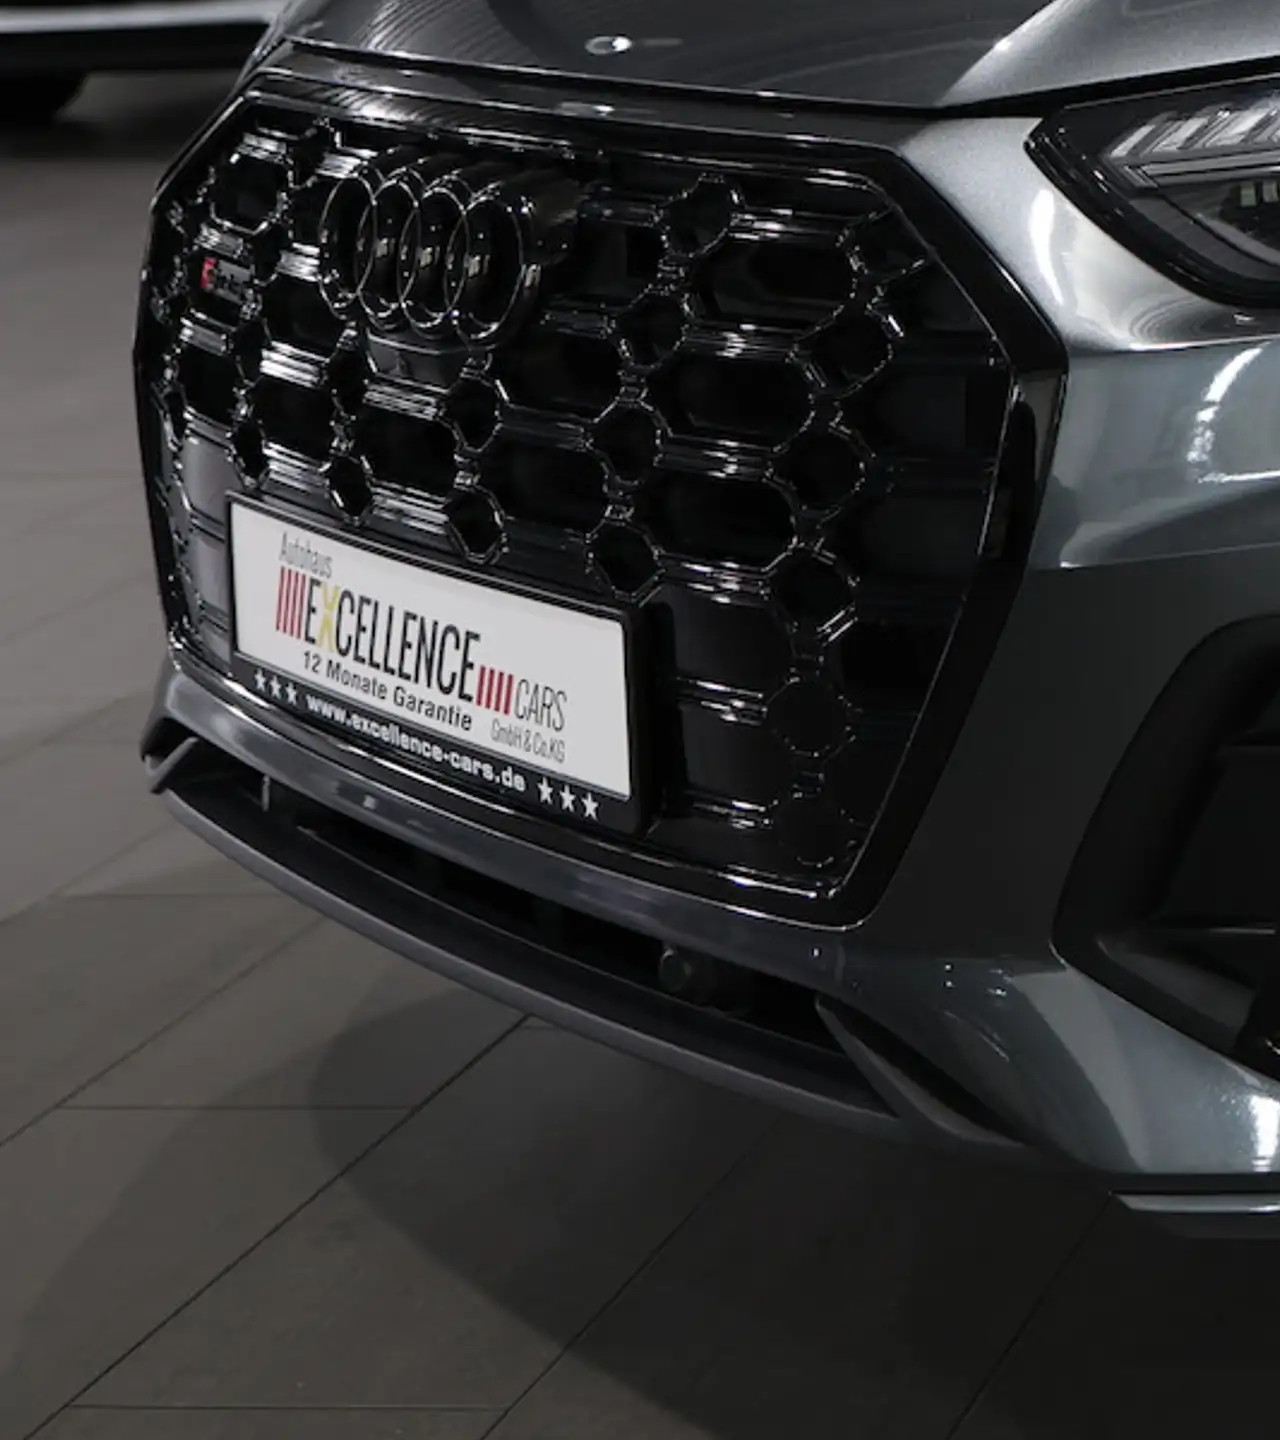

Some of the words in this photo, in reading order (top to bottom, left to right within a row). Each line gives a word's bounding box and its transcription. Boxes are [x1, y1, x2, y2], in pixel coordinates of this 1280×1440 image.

[279, 531, 333, 579] Autohaus
[303, 649, 323, 674] 12
[326, 658, 389, 701] Monate
[393, 685, 473, 732] Garantie
[304, 576, 481, 703] EXCELLENCE
[514, 678, 568, 732] CARS
[305, 693, 527, 793] www.excellence-cars.de
